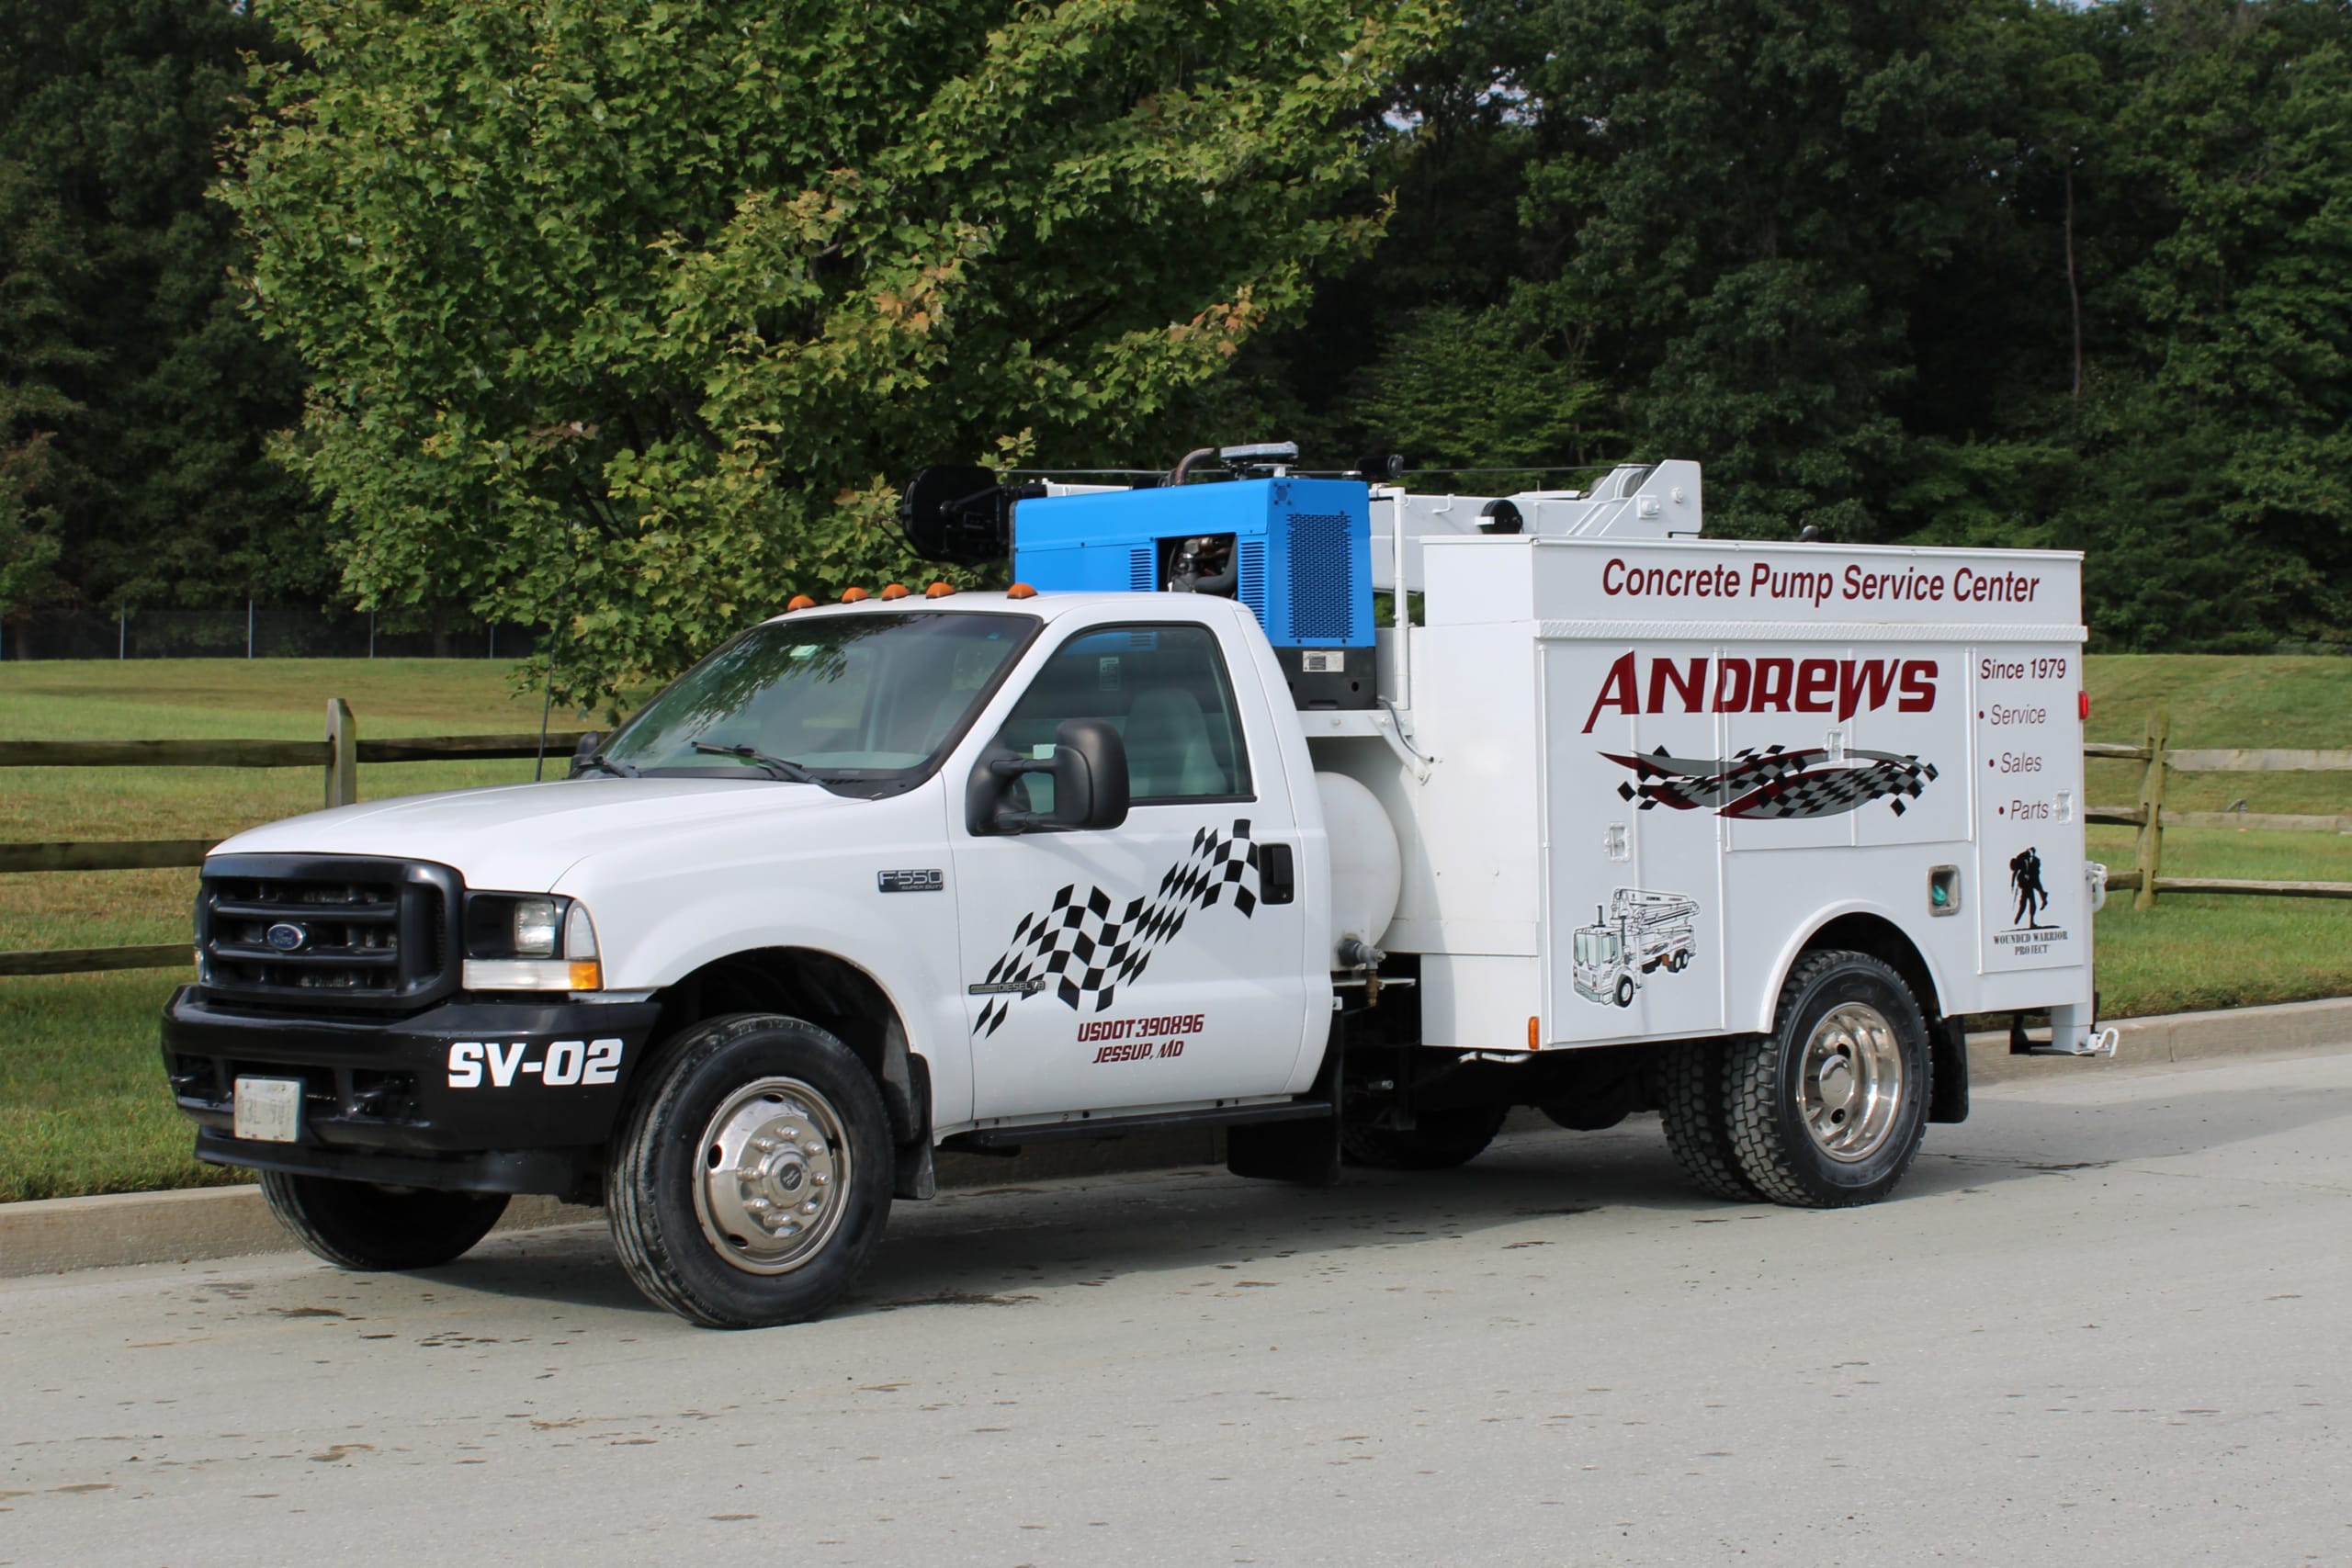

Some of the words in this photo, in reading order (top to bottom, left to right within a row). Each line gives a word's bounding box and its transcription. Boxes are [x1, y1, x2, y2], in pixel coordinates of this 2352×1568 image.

[1602, 558, 1741, 598] Concrete
[1749, 562, 1834, 608] Pump
[1841, 564, 1945, 602] Service
[1952, 567, 2041, 603] Center
[1980, 658, 2025, 680] Since
[2030, 658, 2066, 680] 1979
[1990, 704, 2046, 726] Service
[2000, 751, 2042, 773] Sales
[2010, 798, 2050, 820] Parts
[1994, 933, 2031, 944] WOUNDED
[2032, 931, 2068, 942] WARRIOR
[1156, 1038, 1185, 1059] MD
[447, 1038, 623, 1088] SV-02
